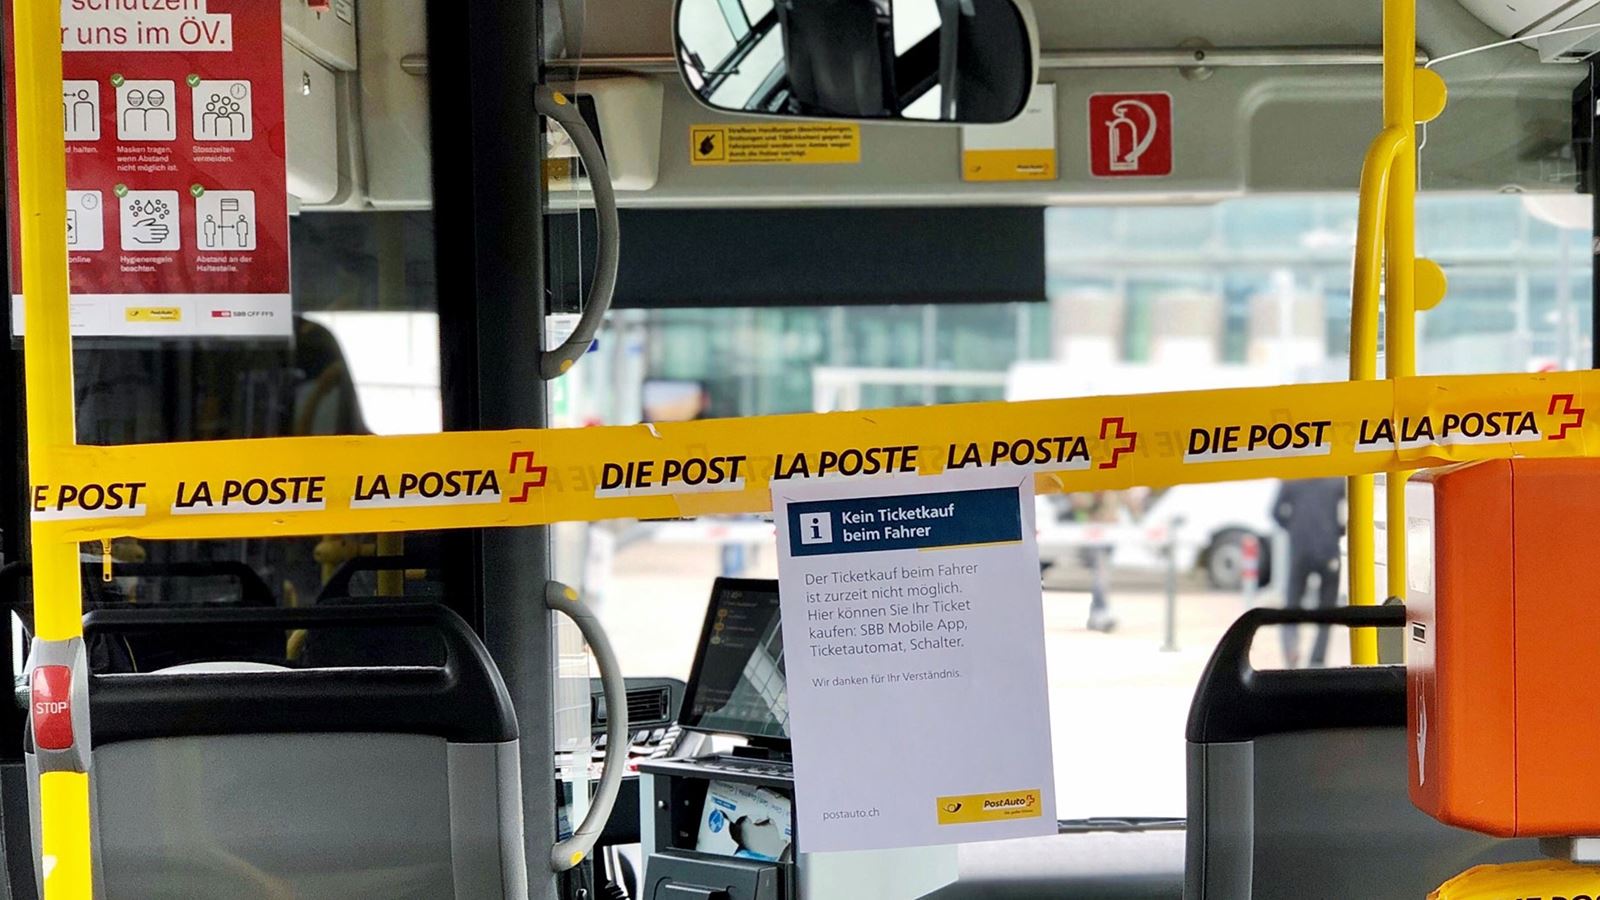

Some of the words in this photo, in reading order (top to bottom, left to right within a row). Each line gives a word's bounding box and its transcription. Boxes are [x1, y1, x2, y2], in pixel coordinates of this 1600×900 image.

[77, 27, 127, 45] uns
[137, 21, 169, 45] im
[179, 17, 225, 45] ÖV.
[116, 145, 145, 153] Masken
[192, 145, 235, 153] Stosszeiten
[137, 164, 166, 173] möglich
[120, 255, 173, 265] Hygieneregeln
[196, 255, 227, 263] Abstand
[239, 255, 253, 263] der
[1442, 411, 1539, 438] POSTA
[1187, 426, 1240, 455] DIE
[1247, 420, 1331, 452] POST
[773, 452, 812, 480] LA
[818, 445, 919, 477] POSTE
[946, 441, 986, 469] LA
[990, 435, 1091, 466] POSTA
[600, 460, 654, 490] DIE
[661, 455, 746, 486] POST
[175, 480, 213, 508] LA
[221, 476, 325, 506] POSTE
[354, 474, 390, 500] LA
[398, 469, 500, 499] POSTA
[57, 482, 147, 511] POST
[842, 510, 875, 525] Kein
[878, 503, 955, 523] Ticketkauf
[843, 528, 880, 543] beim
[884, 524, 931, 540] Fahrer
[805, 573, 828, 586] Der
[831, 568, 899, 584] Ticketkauf
[901, 566, 934, 580] beim
[938, 562, 978, 577] Fahrer
[806, 590, 821, 603] ist
[824, 588, 868, 603] zurzeit
[871, 586, 903, 600] nicht
[907, 582, 962, 600] möglich.
[808, 608, 833, 621] Hier
[838, 605, 886, 620] können
[889, 603, 909, 616] Sie
[912, 601, 930, 614] Ihr
[933, 599, 971, 613] Ticket
[809, 624, 857, 640] kaufen:
[860, 623, 884, 637] SBB
[888, 619, 934, 635] Mobile
[937, 618, 968, 635] App,
[810, 641, 907, 657] Ticketautomat,
[910, 636, 965, 651] Schalter.
[812, 678, 830, 688] Wir
[832, 676, 868, 687] danken
[871, 674, 885, 684] für
[887, 673, 900, 683] Ihr
[902, 669, 961, 682] Verständnis.
[36, 701, 67, 714] STOP
[984, 797, 1026, 808] PostAuto
[822, 807, 880, 821] postauto.ch
